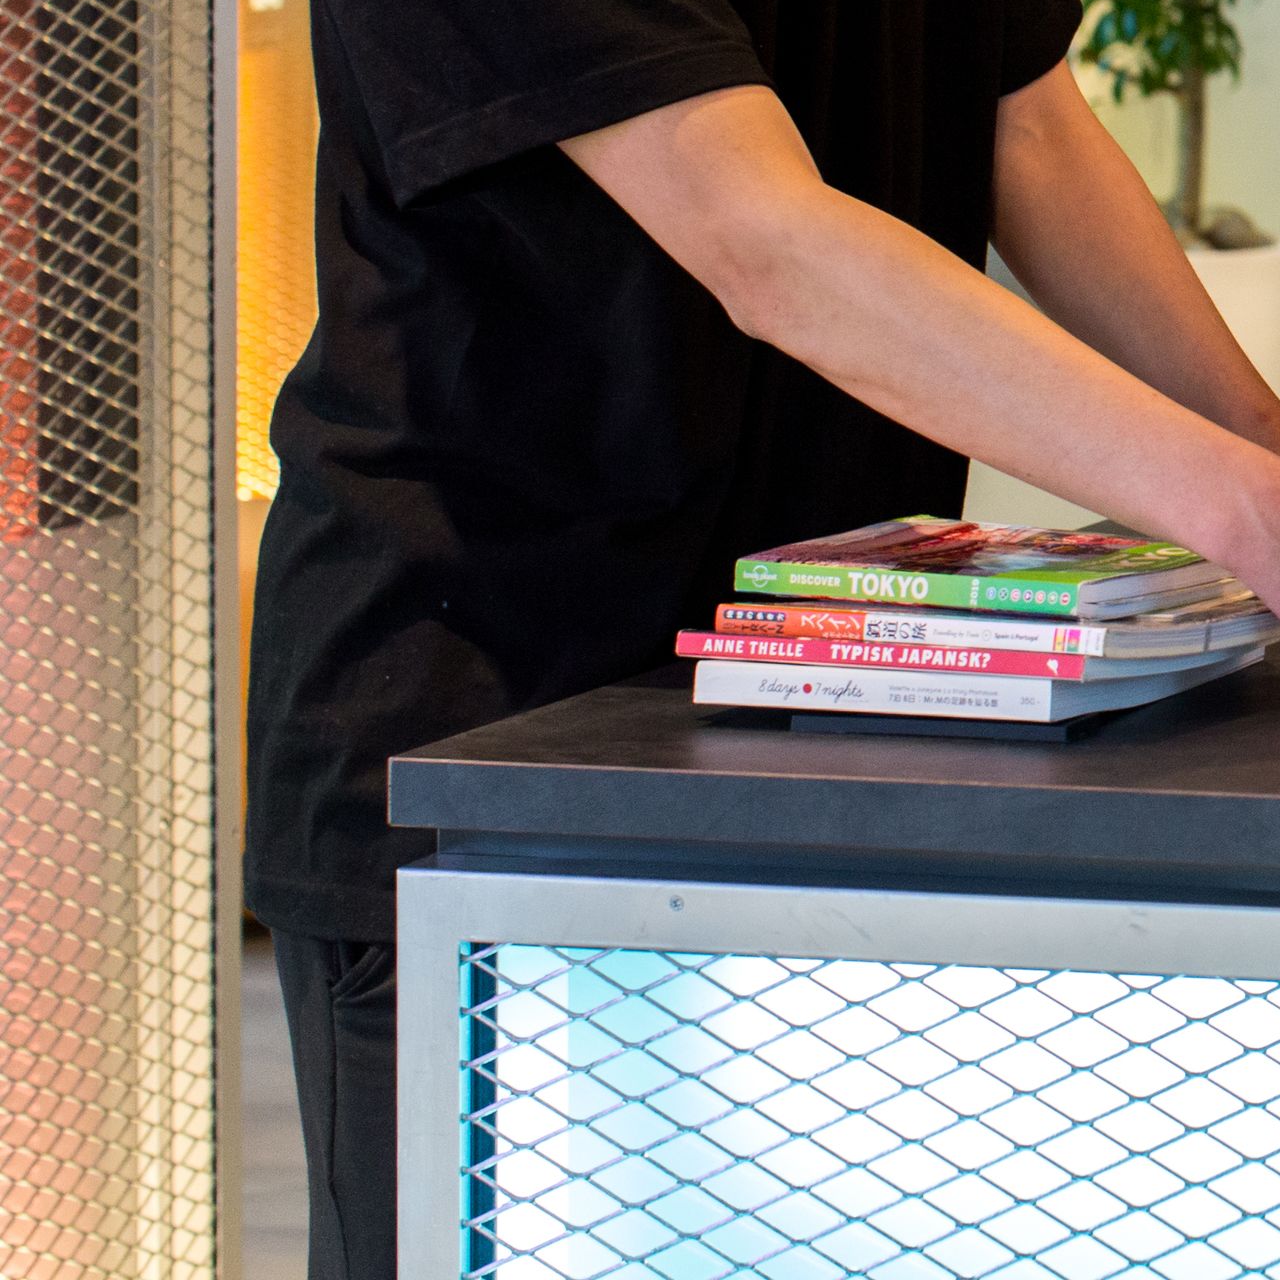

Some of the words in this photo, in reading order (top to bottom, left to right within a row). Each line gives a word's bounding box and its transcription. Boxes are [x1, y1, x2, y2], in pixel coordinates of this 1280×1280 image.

[789, 574, 841, 587] DISCOVER
[847, 571, 929, 600] TOKYO
[741, 623, 785, 634] TRAIN
[800, 613, 861, 630] スペイン
[866, 620, 928, 640] 鉄道の旅
[1015, 633, 1039, 642] Portugal
[703, 638, 744, 653] ANNE
[750, 641, 804, 657] THELLE
[830, 644, 894, 662] TYPISK
[898, 648, 991, 668] JAPANSK?
[758, 679, 799, 695] 8days
[815, 680, 864, 704] 7nights
